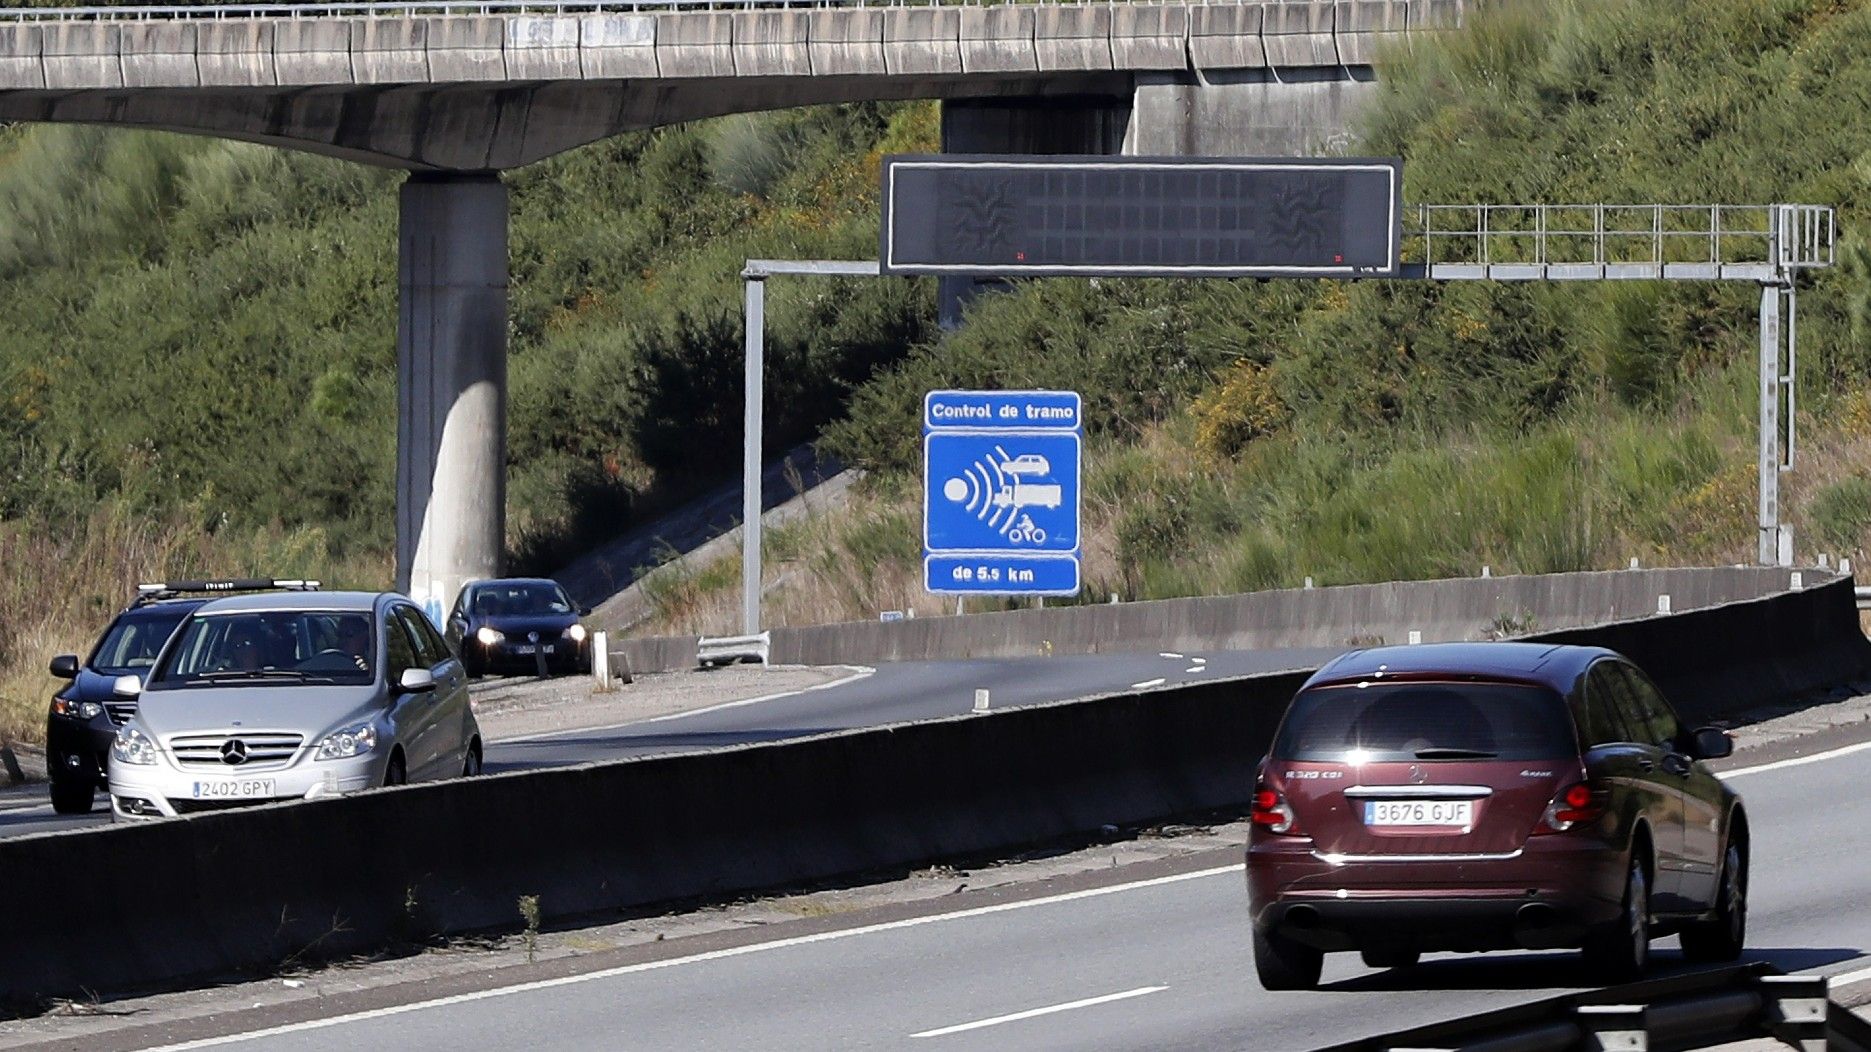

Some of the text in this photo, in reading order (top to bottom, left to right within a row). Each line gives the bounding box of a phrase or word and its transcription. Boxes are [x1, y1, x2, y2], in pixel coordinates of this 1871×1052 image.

[932, 403, 1074, 419] Control de tramo
[952, 565, 972, 580] de
[1008, 567, 1034, 582] km
[202, 781, 271, 797] 2402 GPY
[1377, 803, 1467, 821] 3676 GJF
